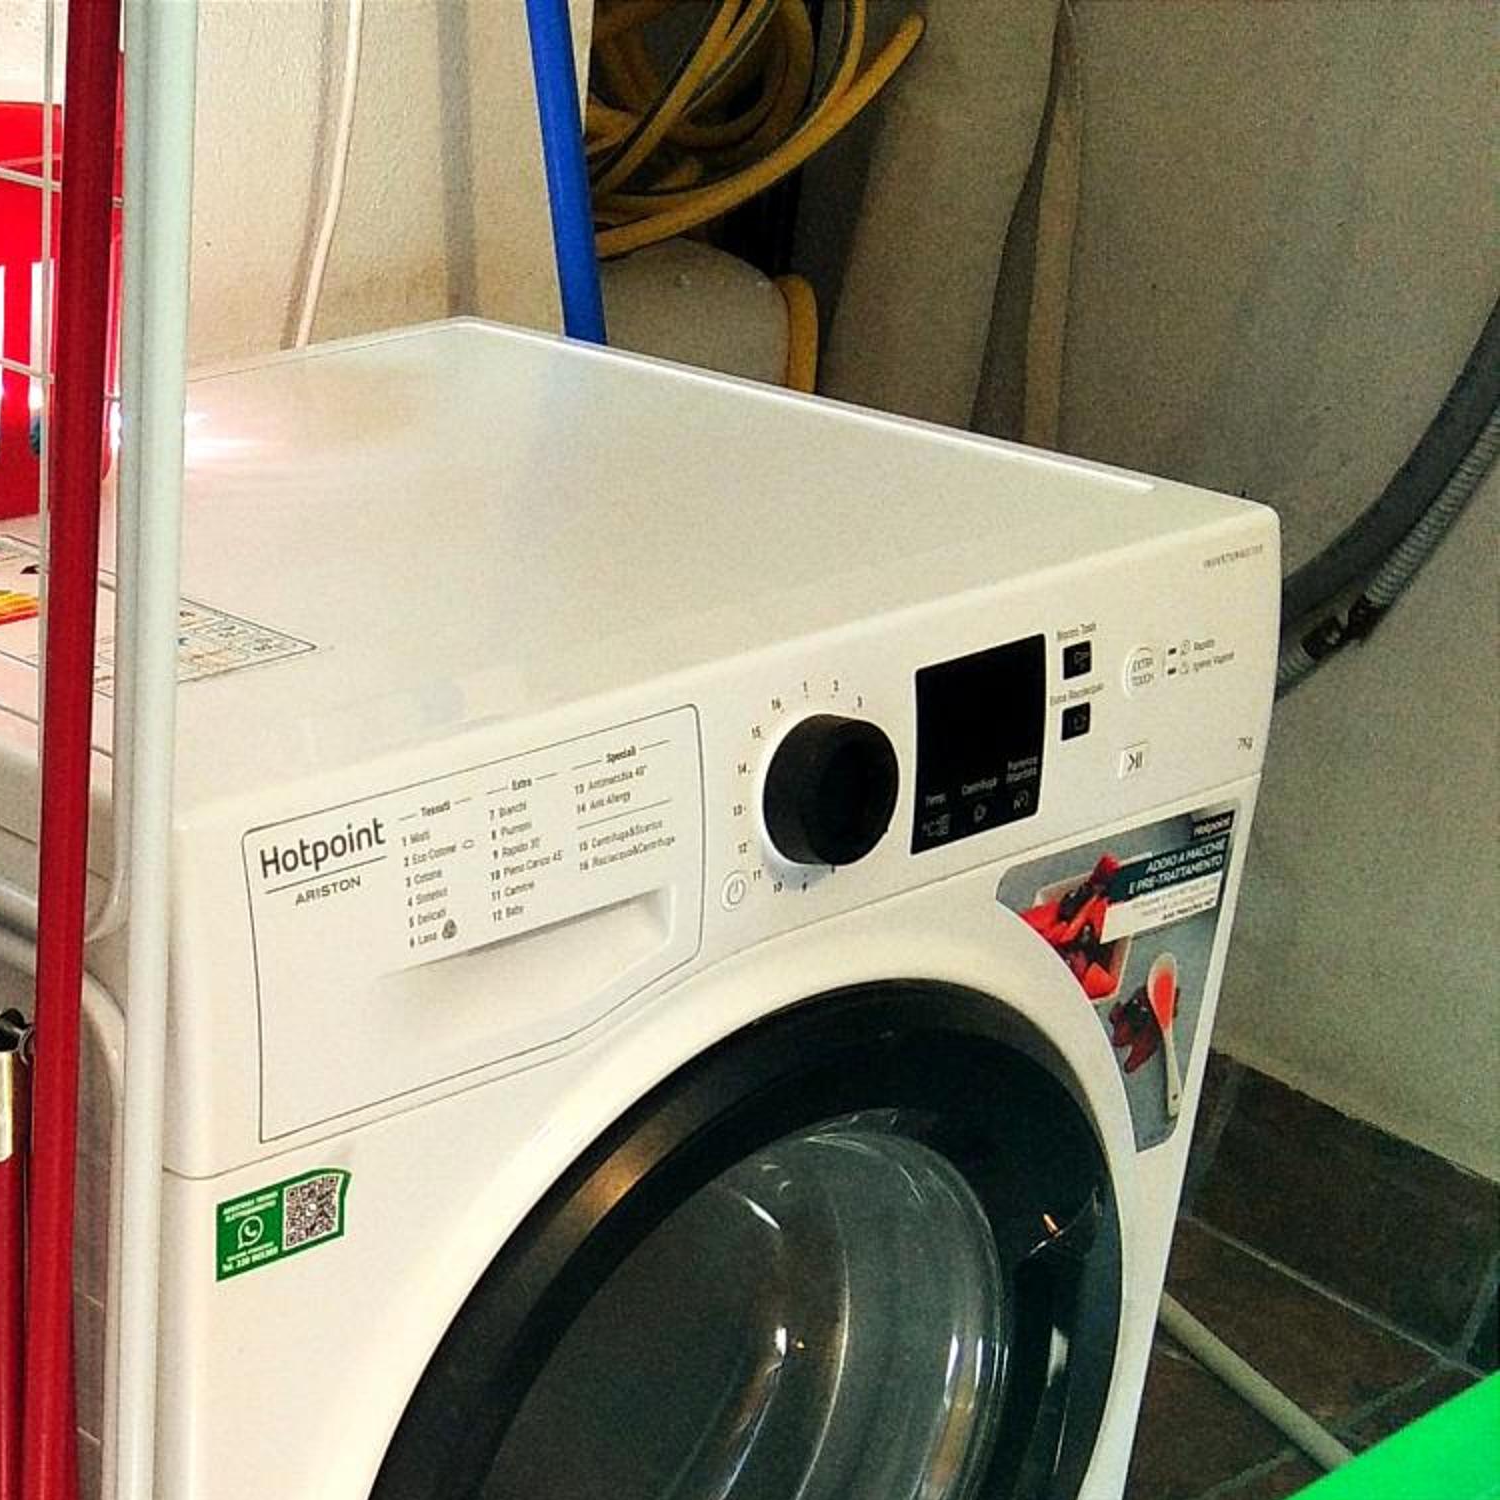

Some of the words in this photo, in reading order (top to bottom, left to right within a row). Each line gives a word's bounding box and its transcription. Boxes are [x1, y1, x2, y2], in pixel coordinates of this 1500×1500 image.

[833, 679, 839, 692] 2
[751, 725, 761, 738] 15
[737, 763, 747, 776] 14
[260, 818, 386, 879] Hotpoint
[1145, 854, 1178, 875] ADDIO
[1179, 852, 1186, 863] A
[1186, 838, 1227, 860] MACCHIE
[1128, 881, 1136, 895] E
[1136, 854, 1223, 890] PRE-TRATTAMENTO
[295, 876, 362, 906] ARISTON
